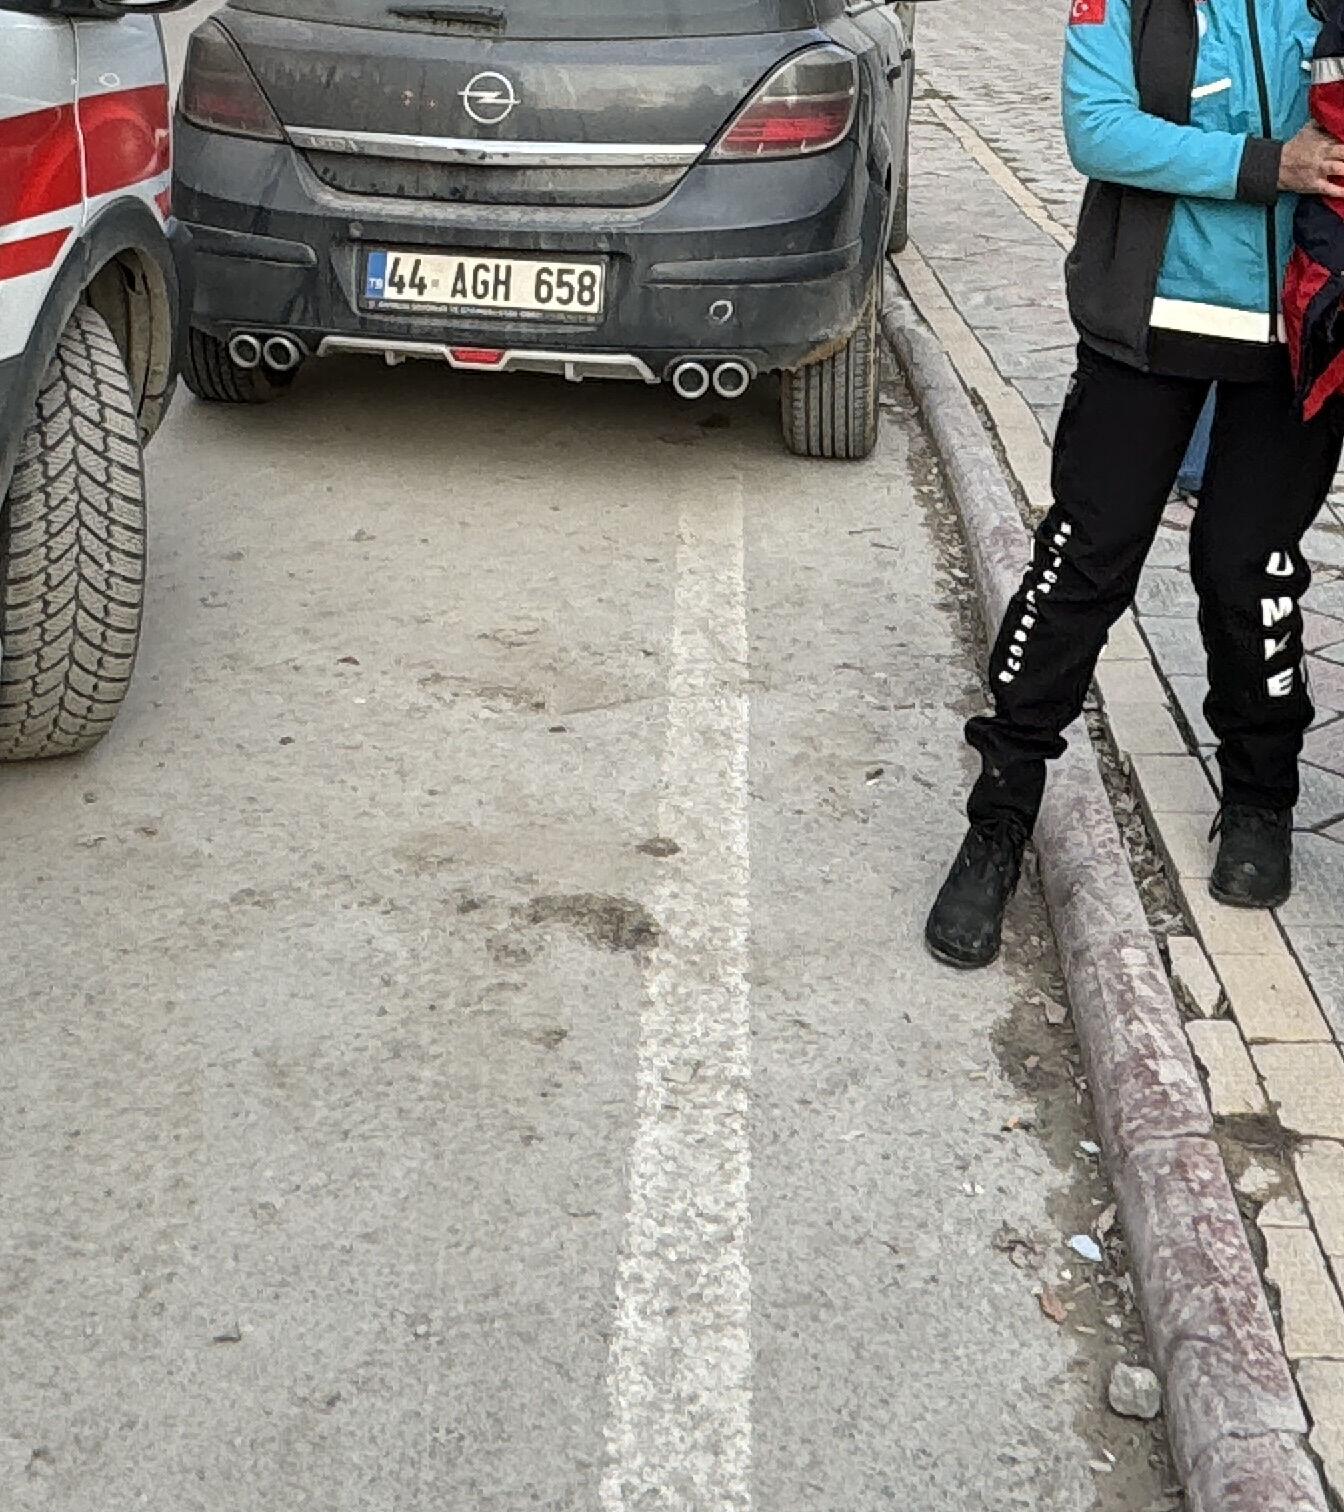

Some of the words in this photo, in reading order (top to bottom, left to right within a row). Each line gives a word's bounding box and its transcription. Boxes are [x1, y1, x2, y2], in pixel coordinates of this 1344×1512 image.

[388, 256, 428, 296] 44
[450, 262, 512, 302] AGH
[534, 266, 597, 306] 658
